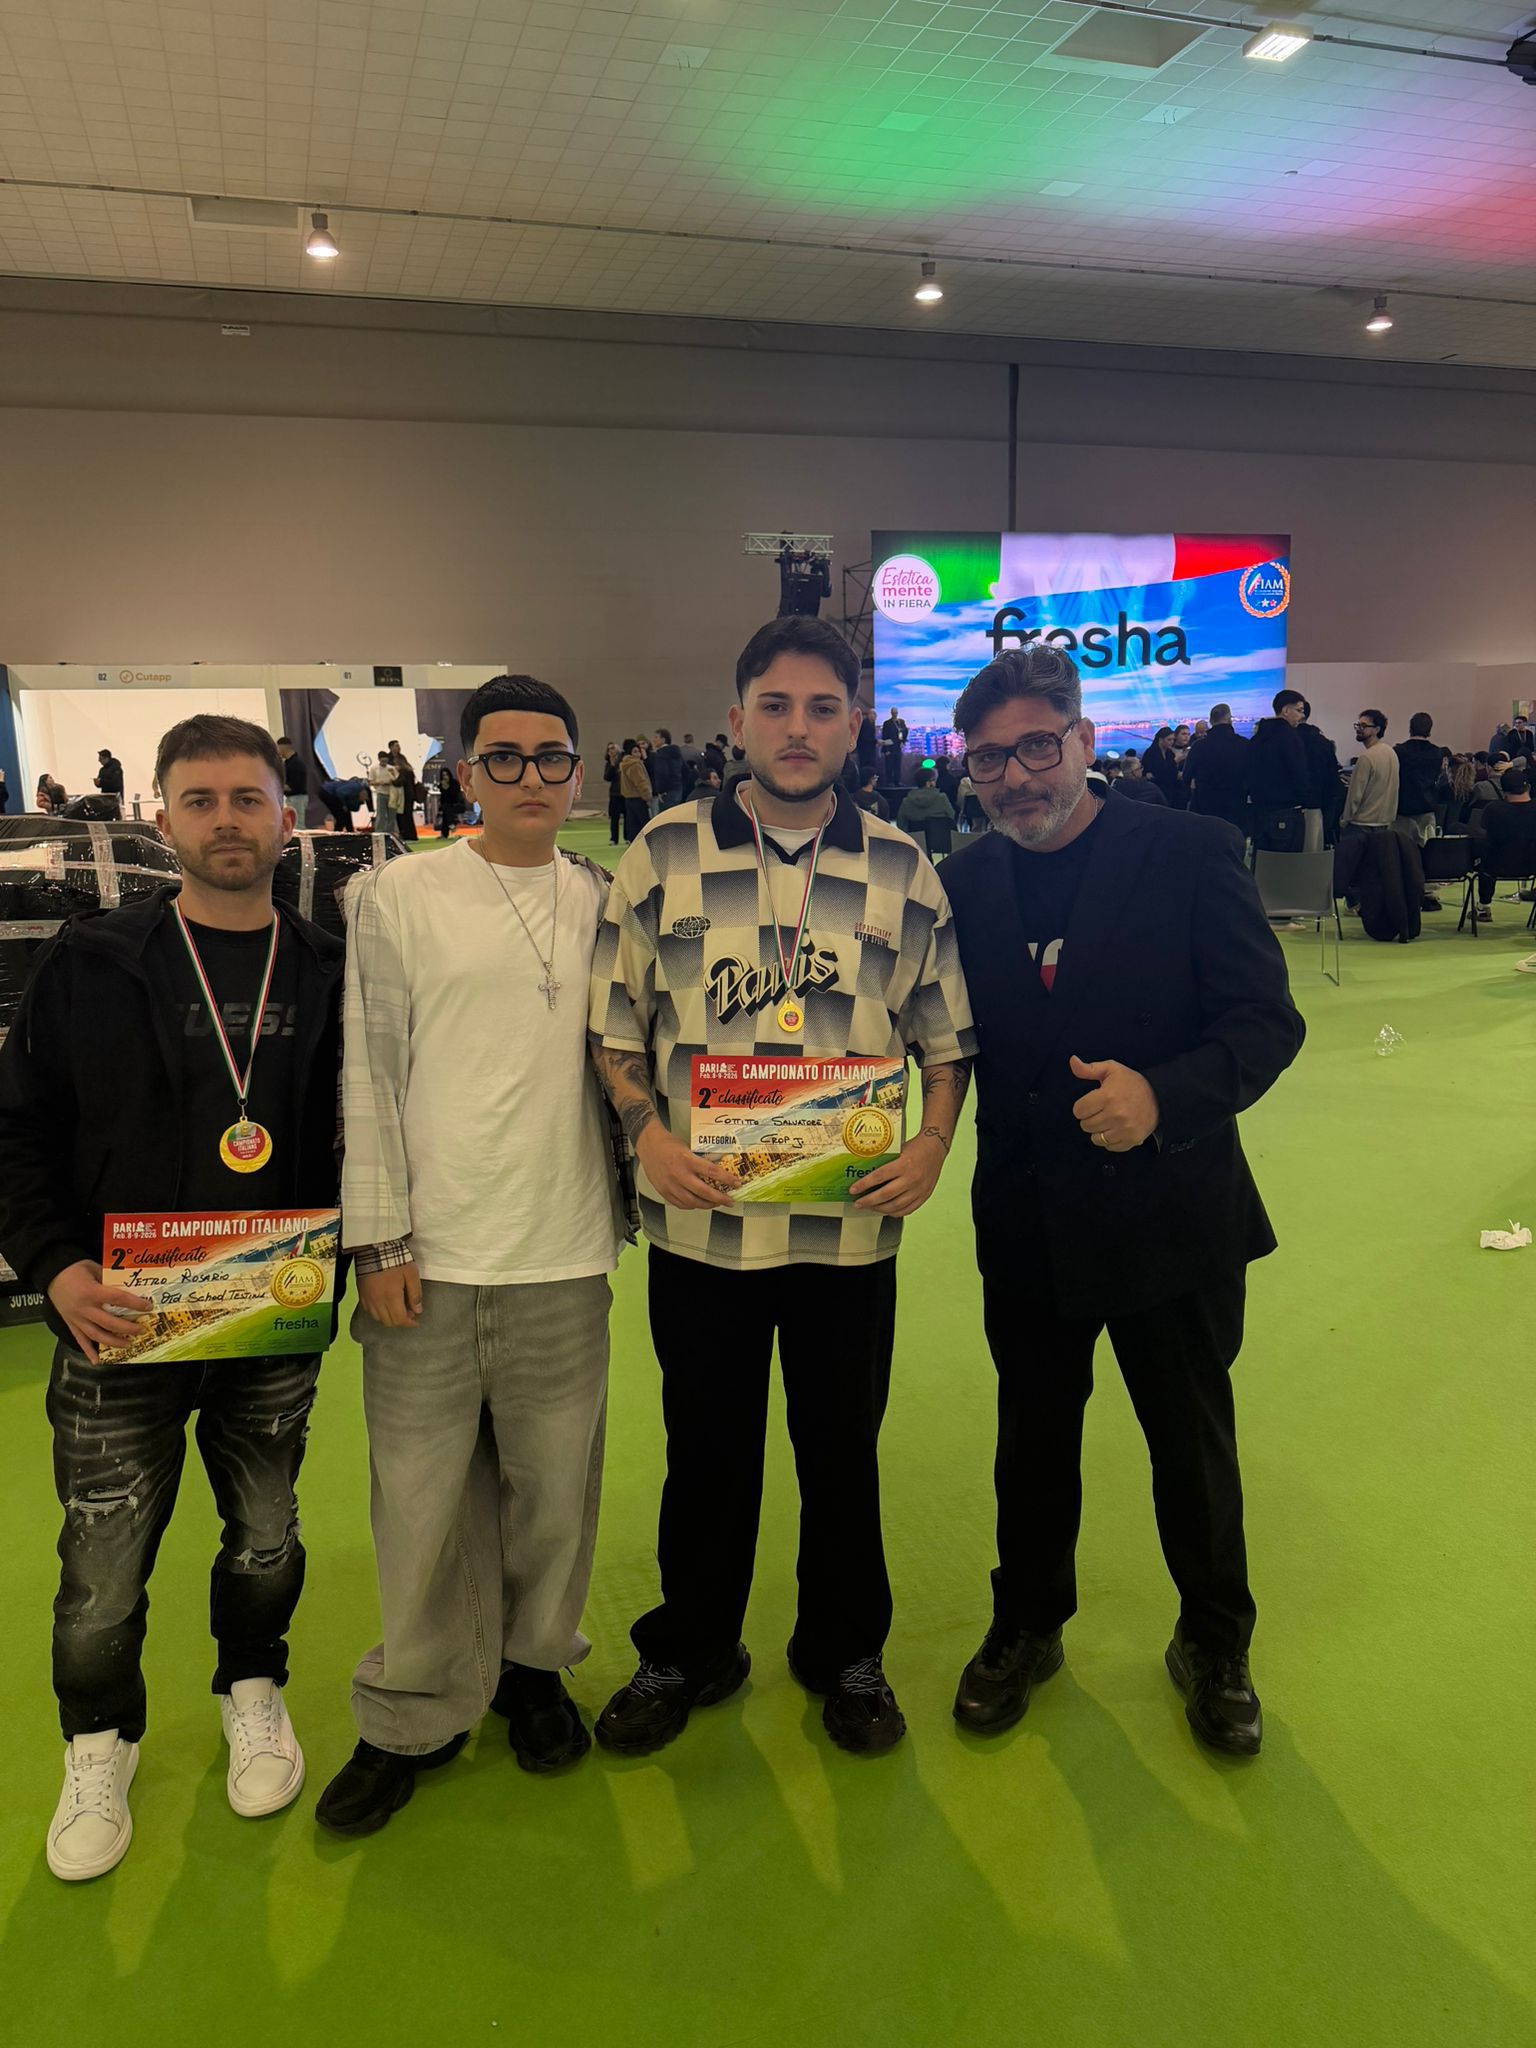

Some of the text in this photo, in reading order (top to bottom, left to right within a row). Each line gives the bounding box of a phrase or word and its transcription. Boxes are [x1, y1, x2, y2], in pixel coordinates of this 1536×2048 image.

[882, 567, 933, 585] Estetica
[882, 586, 933, 597] mente
[883, 600, 932, 609] IN FIERA
[136, 673, 172, 682] Cutapp
[700, 1063, 719, 1073] BARI
[742, 1064, 818, 1080] CAMPIONATO
[823, 1065, 876, 1080] ITALIANO
[718, 1089, 785, 1110] classificato
[698, 1136, 737, 1145] CATEGORIA
[113, 1223, 136, 1233] BARI
[162, 1220, 247, 1238] CAMPIONATO
[251, 1217, 309, 1234] ITALIANO
[133, 1247, 209, 1267] classificato
[272, 1317, 320, 1331] fresha
